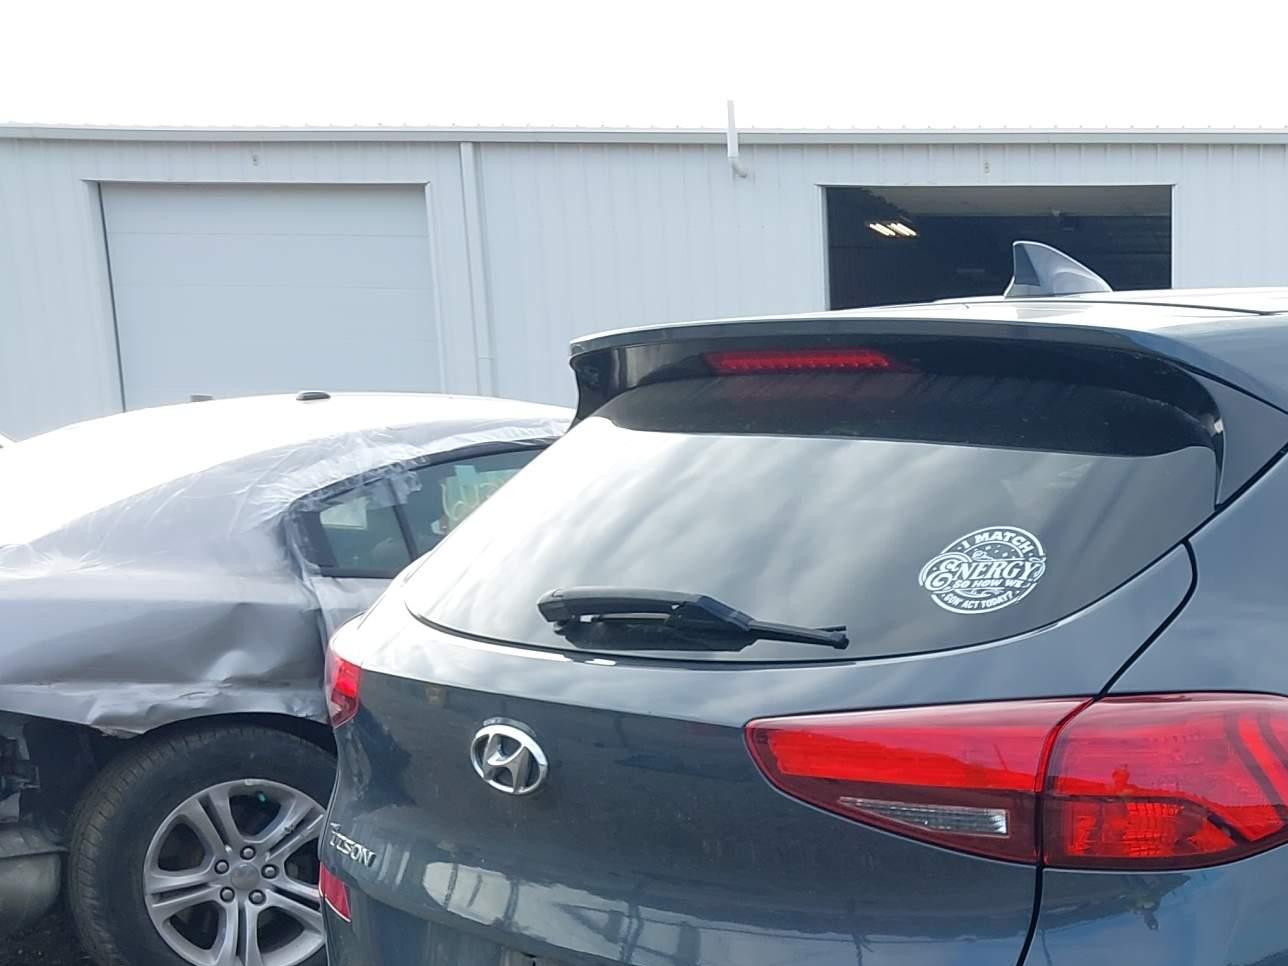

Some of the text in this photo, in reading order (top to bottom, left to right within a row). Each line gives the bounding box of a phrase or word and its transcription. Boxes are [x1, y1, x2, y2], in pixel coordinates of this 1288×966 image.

[974, 531, 1035, 554] MATCH
[952, 580, 971, 589] SO
[972, 579, 1003, 588] HOW
[961, 600, 980, 609] ACT
